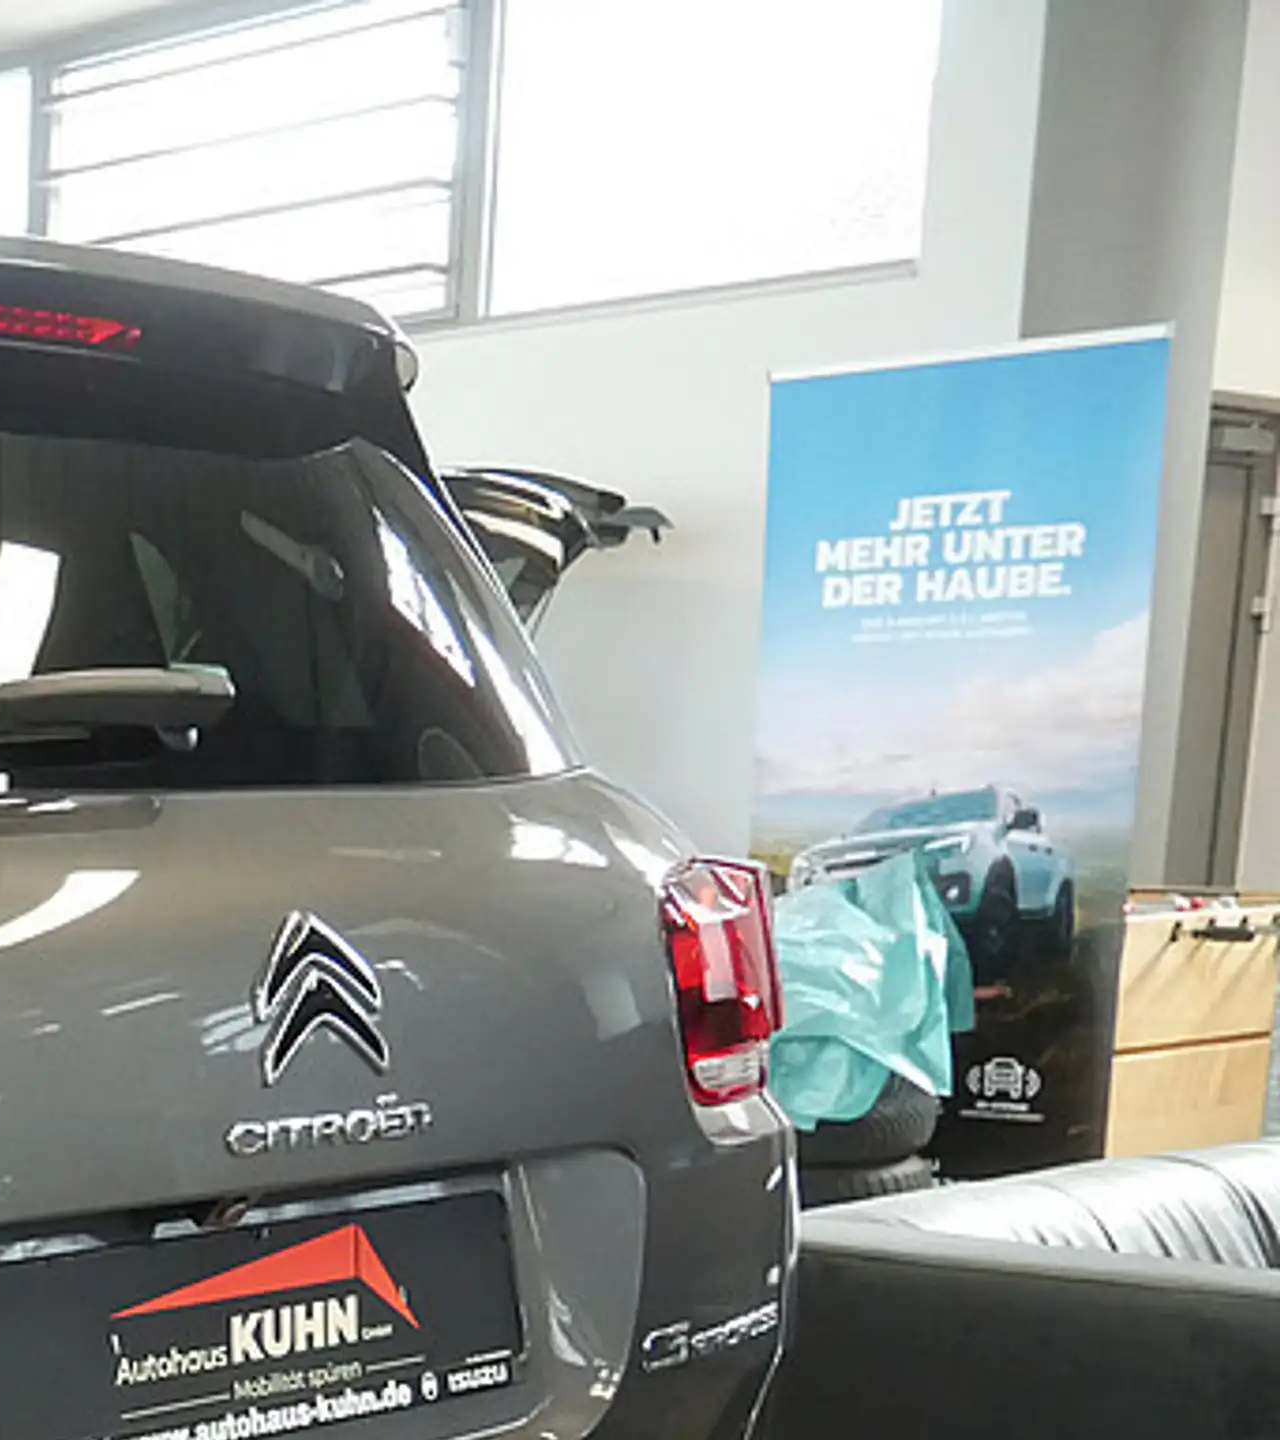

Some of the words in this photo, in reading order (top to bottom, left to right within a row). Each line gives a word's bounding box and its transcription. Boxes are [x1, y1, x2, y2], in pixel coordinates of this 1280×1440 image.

[889, 489, 1012, 530] JETZT
[815, 534, 931, 573] MEHR
[943, 522, 1087, 564] UNTER
[822, 572, 903, 609] DER
[916, 562, 1072, 602] HAUBE.
[115, 1345, 228, 1386] Autohaus
[230, 1294, 359, 1364] KUHN
[233, 1371, 306, 1400] Mobilität
[308, 1361, 363, 1390] spüren
